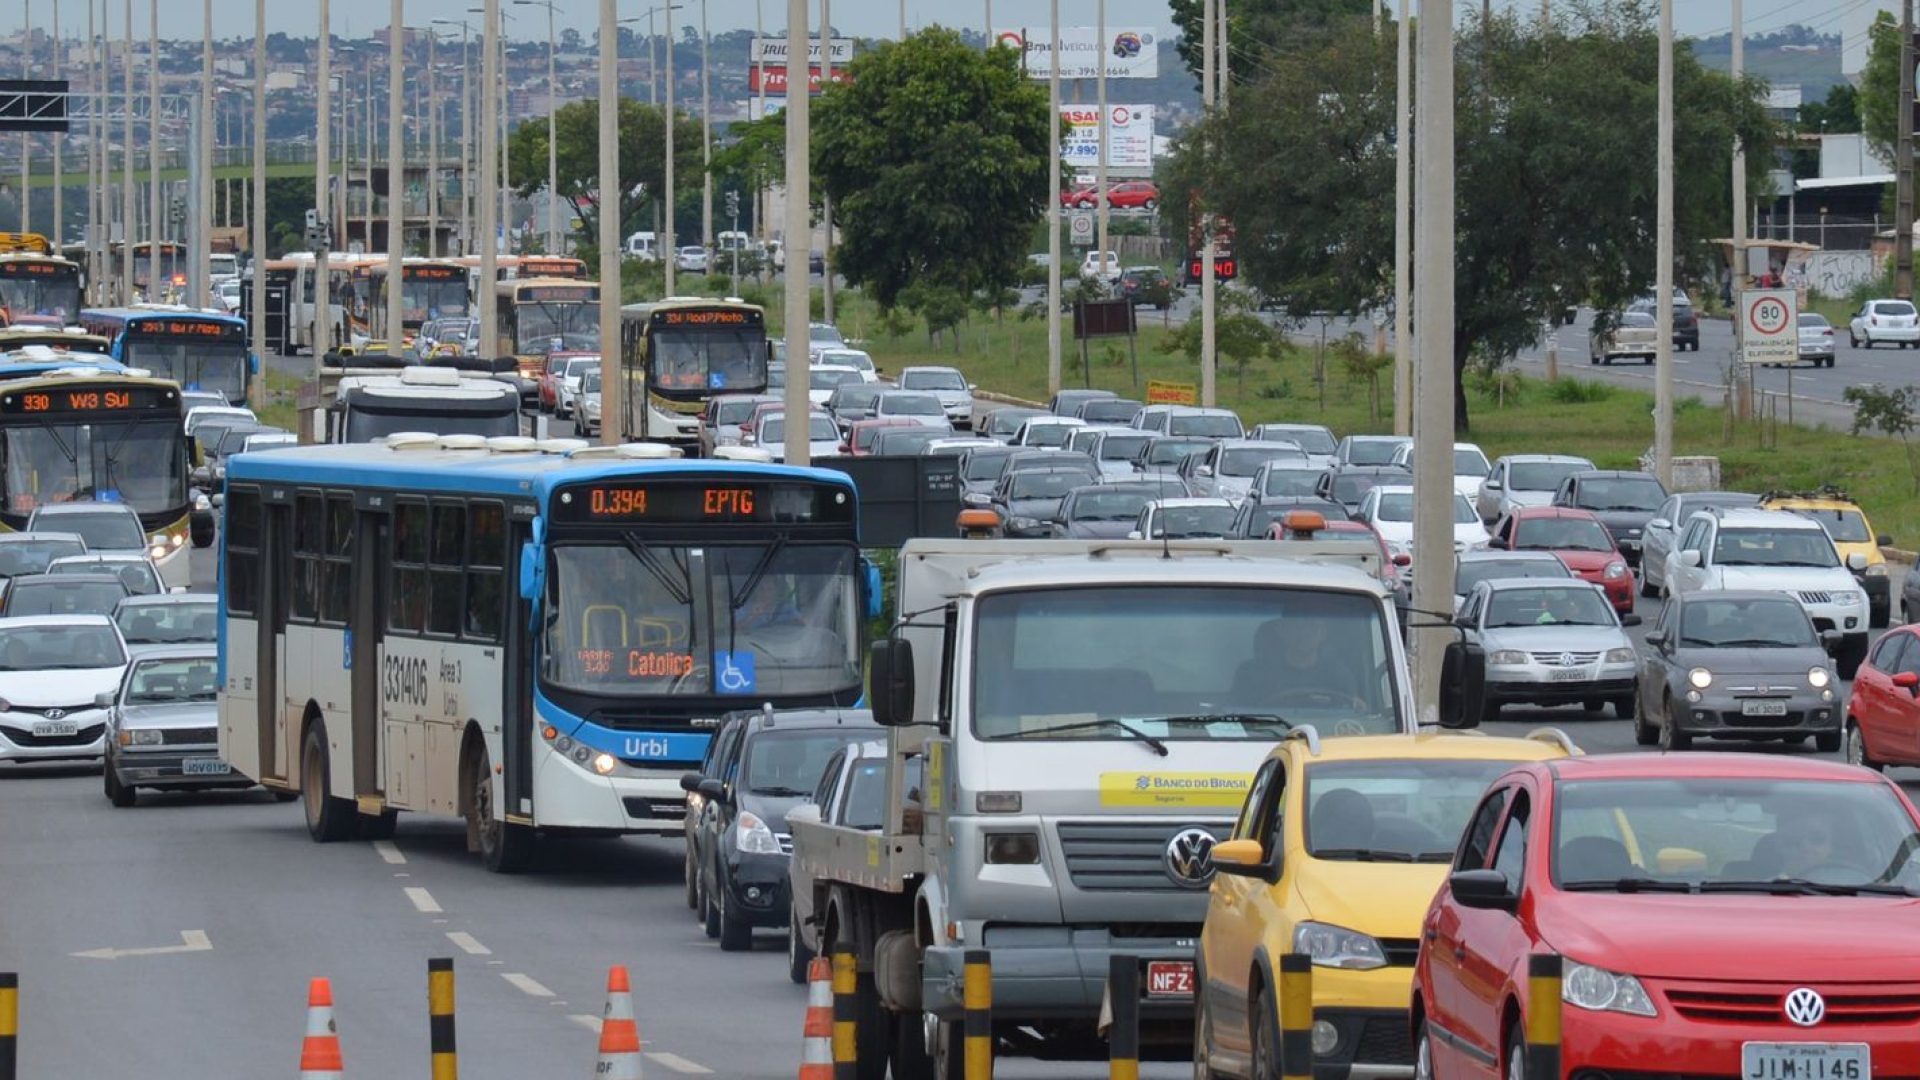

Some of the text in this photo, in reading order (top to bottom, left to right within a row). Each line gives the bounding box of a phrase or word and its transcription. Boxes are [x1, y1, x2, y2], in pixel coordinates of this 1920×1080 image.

[1761, 306, 1779, 319] 80
[70, 393, 98, 409] W3
[104, 391, 129, 408] Sul
[592, 489, 753, 513] 0.394 EPTG
[628, 650, 692, 676] Catolica
[385, 654, 428, 707] 331406
[624, 738, 668, 756] Urbi
[1154, 777, 1192, 788] BANCO
[1210, 778, 1247, 788] BRASIL
